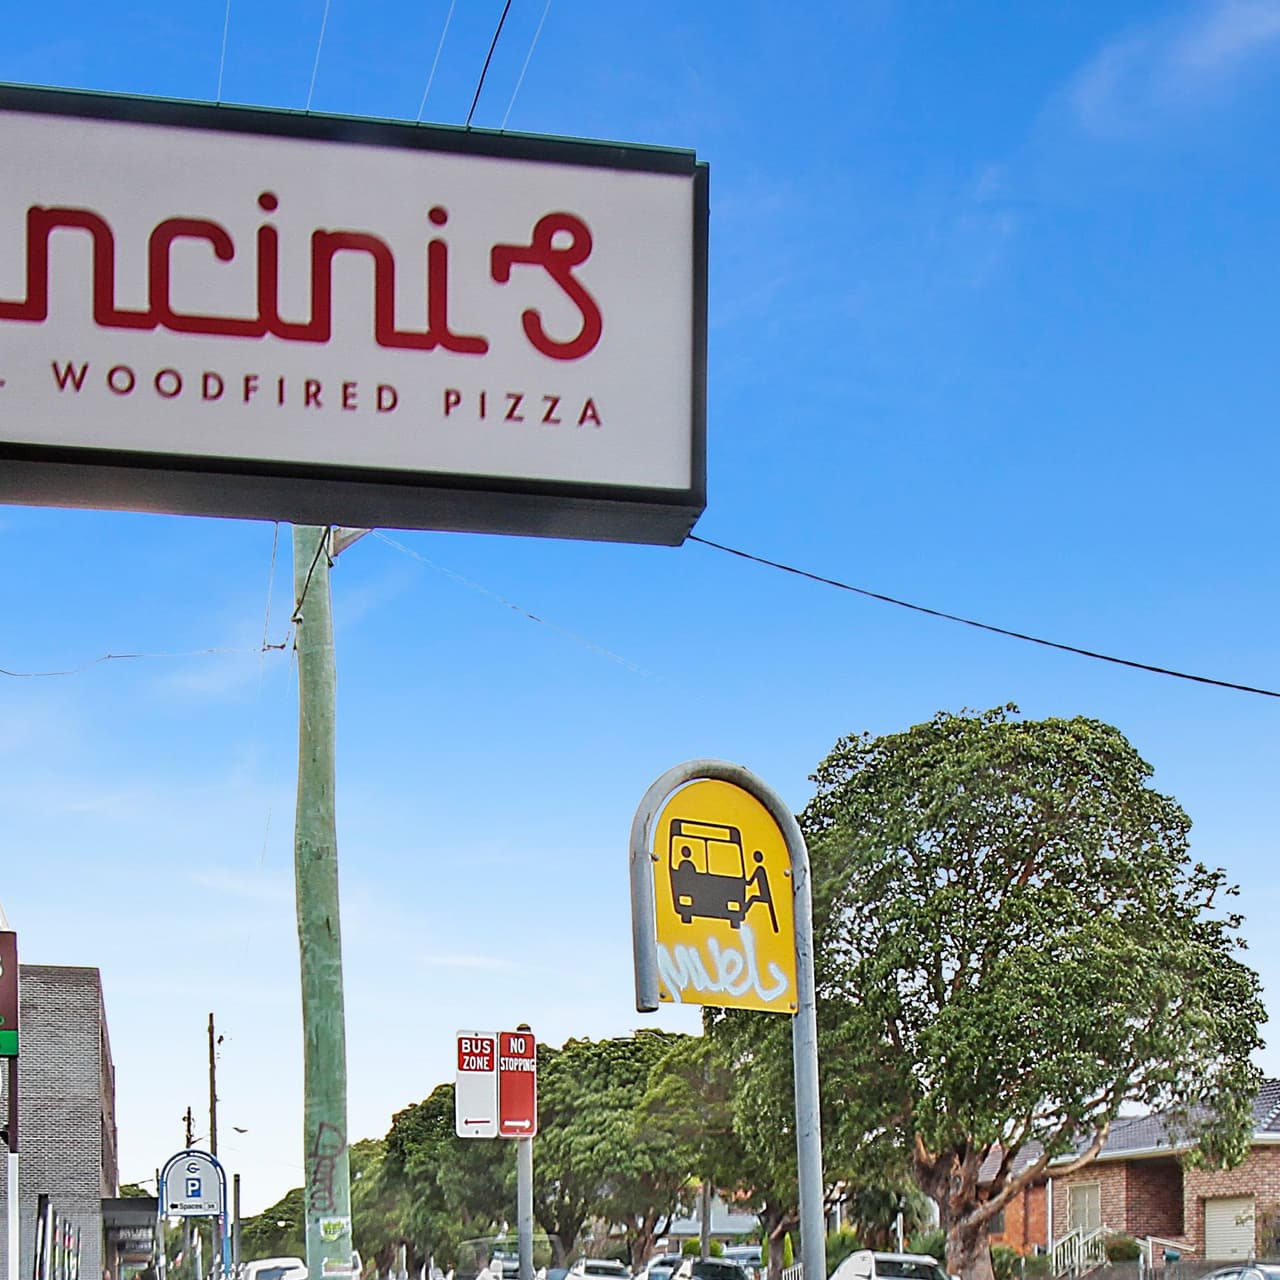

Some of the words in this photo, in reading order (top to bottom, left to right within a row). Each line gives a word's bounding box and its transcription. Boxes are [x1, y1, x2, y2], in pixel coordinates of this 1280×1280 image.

[51, 360, 399, 413] WOODFIRED
[443, 388, 603, 428] PIZZA
[461, 1039, 491, 1054] BUS
[509, 1037, 526, 1054] NO
[462, 1055, 490, 1070] ZONE
[500, 1057, 536, 1072] STOPPING
[187, 1180, 200, 1197] P
